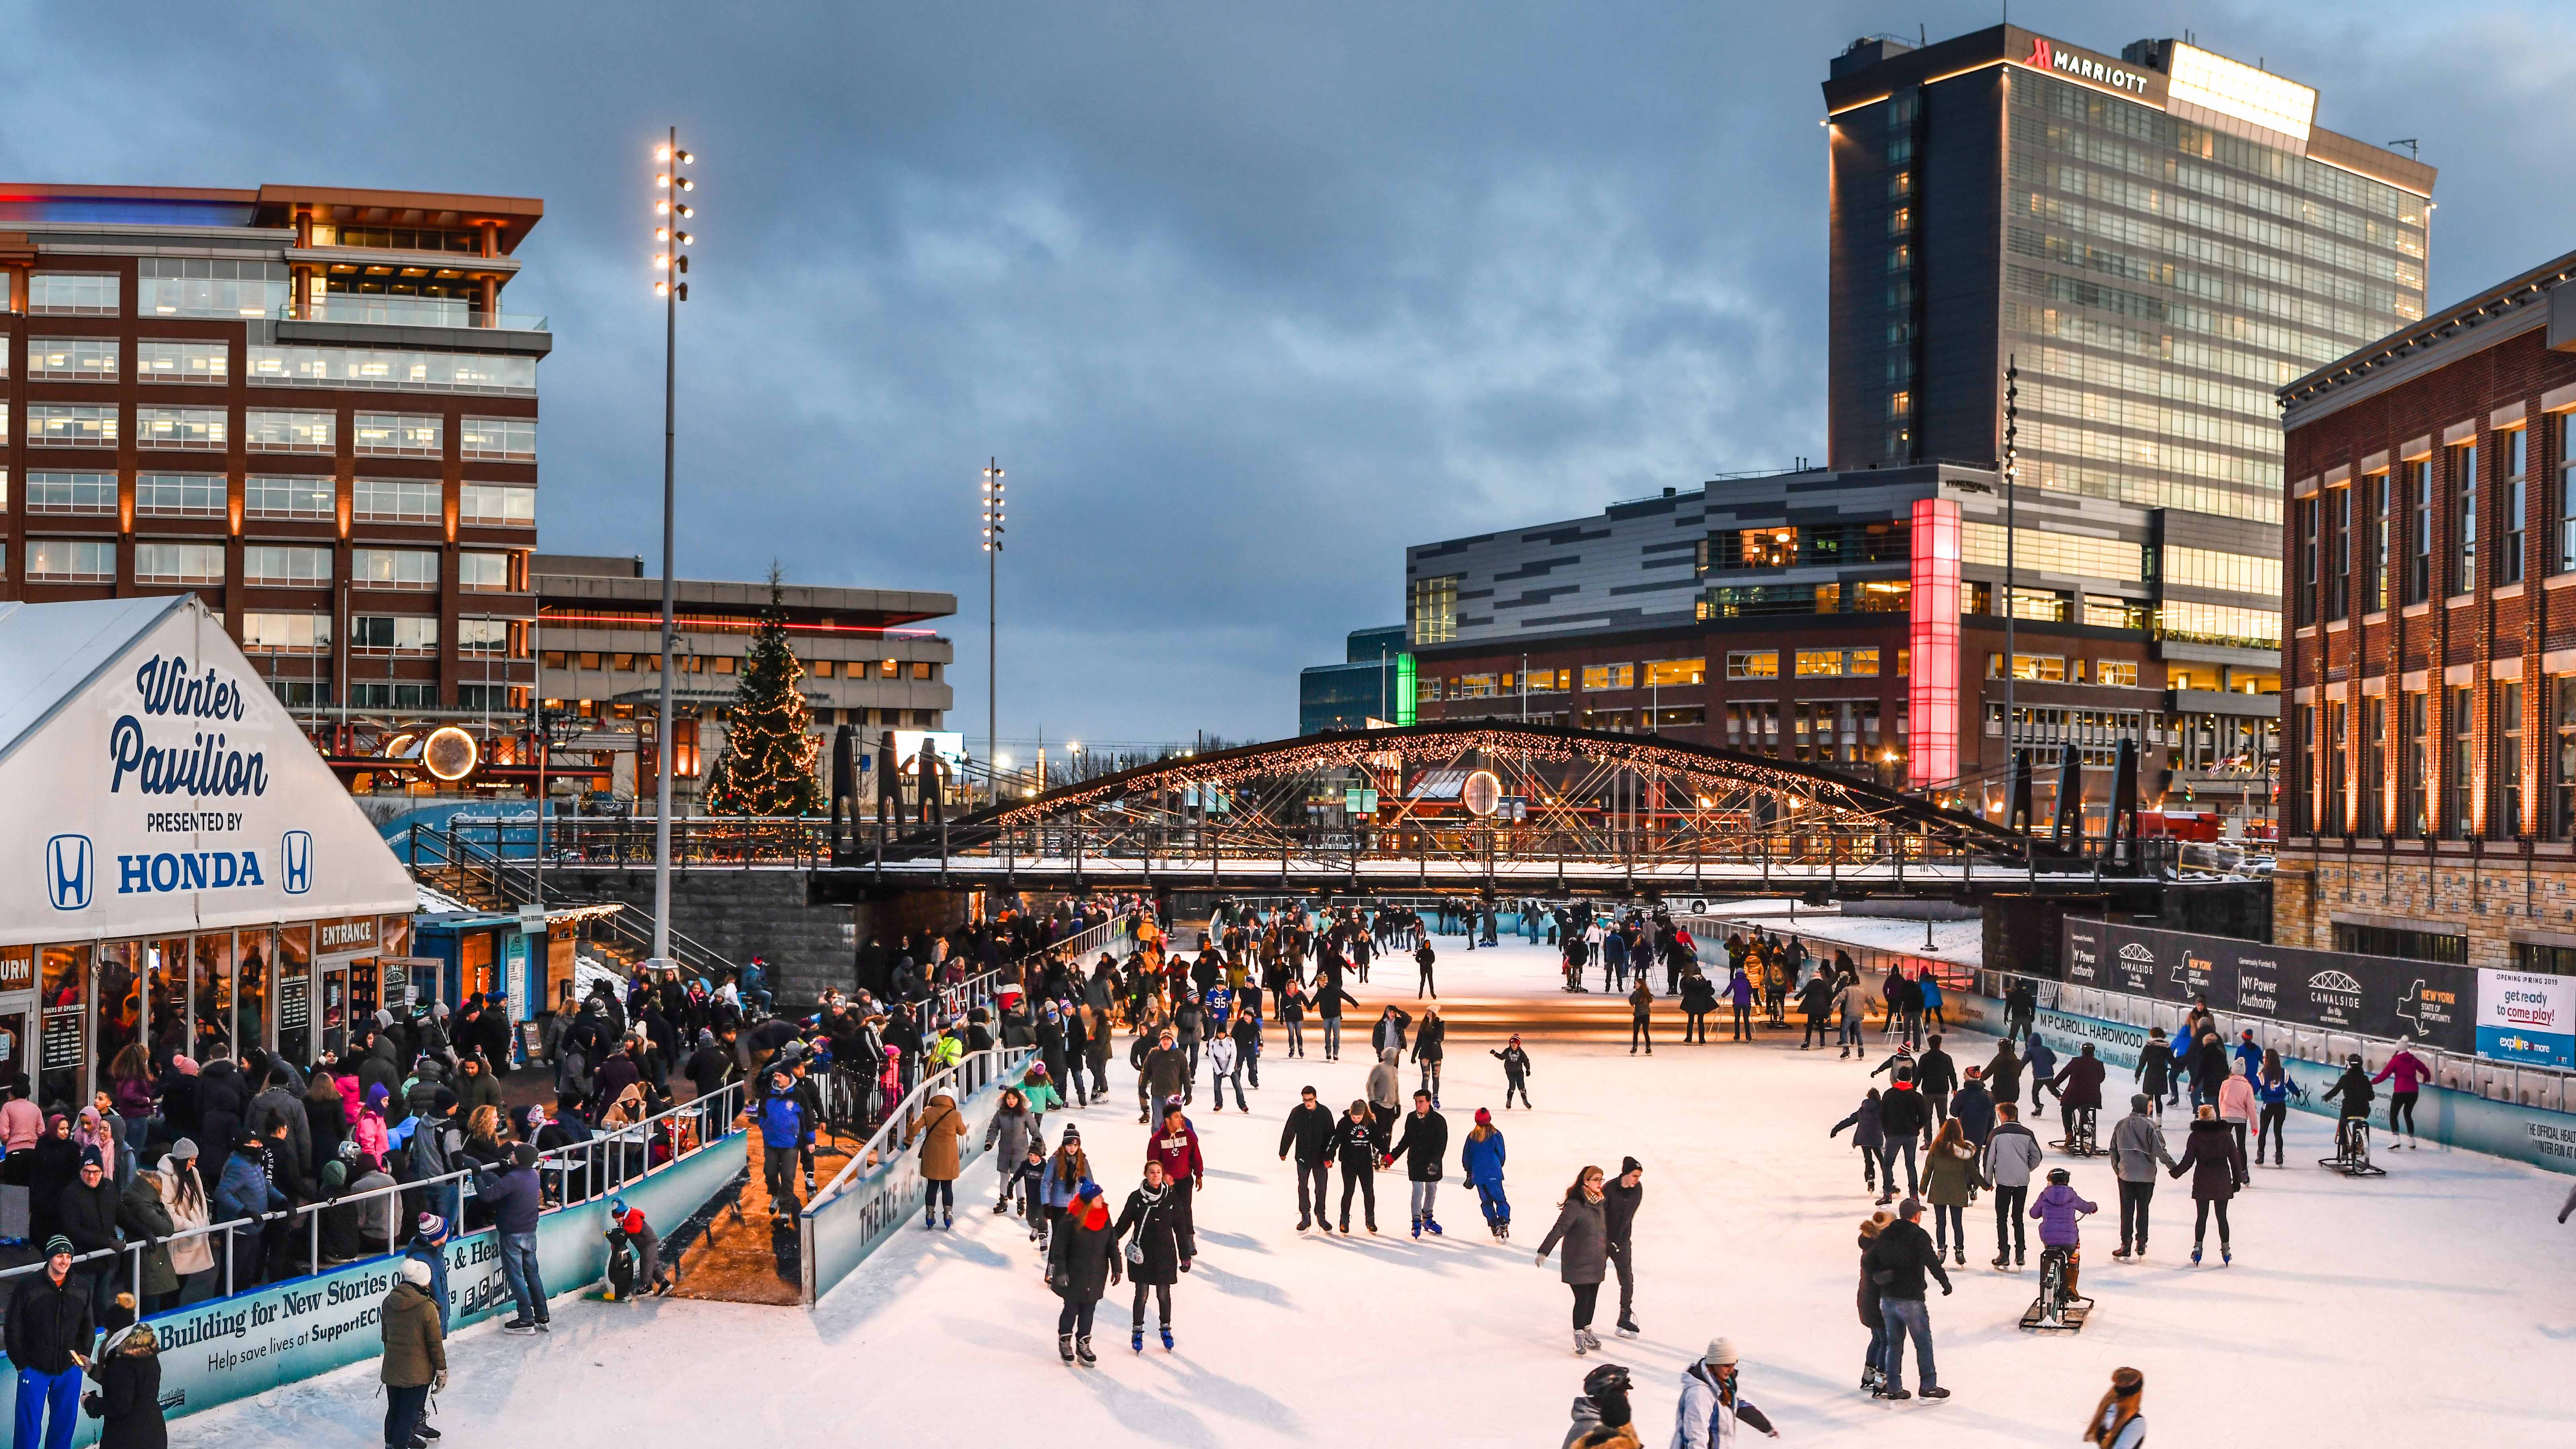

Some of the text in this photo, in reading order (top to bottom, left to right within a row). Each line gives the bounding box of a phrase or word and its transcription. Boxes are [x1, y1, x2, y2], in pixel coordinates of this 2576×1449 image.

[2053, 51, 2147, 94] MARRIOTT
[137, 654, 244, 722] Winter
[110, 715, 268, 797] Pavilion
[148, 813, 242, 832] PRESENTED BY
[118, 851, 264, 893] HONDA
[323, 922, 370, 946] ENTRANCE
[2080, 951, 2095, 963] Power
[2189, 959, 2212, 971] NEW YORK
[2239, 957, 2277, 970] Generously Funded By
[2072, 964, 2095, 981] Authority
[2242, 976, 2277, 994] NY Power
[1214, 997, 1226, 1008] 95
[2241, 993, 2277, 1014] Authority
[2311, 992, 2359, 1008] CANALSIDE
[2421, 989, 2455, 1004] NEW YORK
[2505, 990, 2547, 1008] get ready
[2421, 1003, 2434, 1012] STATE
[2497, 1004, 2555, 1025] to come play!
[2421, 1012, 2451, 1023] OPPORTUNITY.
[2040, 1014, 2046, 1027] M
[2048, 1015, 2053, 1027] P
[2054, 1017, 2087, 1036] CAROLL
[2089, 1024, 2143, 1048] HARDWOOD
[2058, 1037, 2074, 1050] Wood
[2104, 1048, 2119, 1061] Since
[2537, 1125, 2559, 1140] OFFICIAL
[2533, 1139, 2553, 1154] WINTER
[2555, 1143, 2565, 1157] FUN
[2566, 1146, 2573, 1158] AT
[860, 1196, 880, 1247] THE
[883, 1182, 897, 1228] ICE
[159, 1309, 246, 1352] Building
[251, 1301, 278, 1328] for
[282, 1290, 322, 1319] New
[327, 1273, 387, 1306] Stories
[391, 1271, 403, 1288] o
[454, 1246, 467, 1270] &
[471, 1240, 500, 1265] Hea
[209, 1347, 237, 1372] Help
[240, 1346, 266, 1363] save
[270, 1337, 294, 1354] lives
[297, 1331, 309, 1346] at
[157, 1391, 170, 1402] Great
[171, 1388, 185, 1397] Lakes
